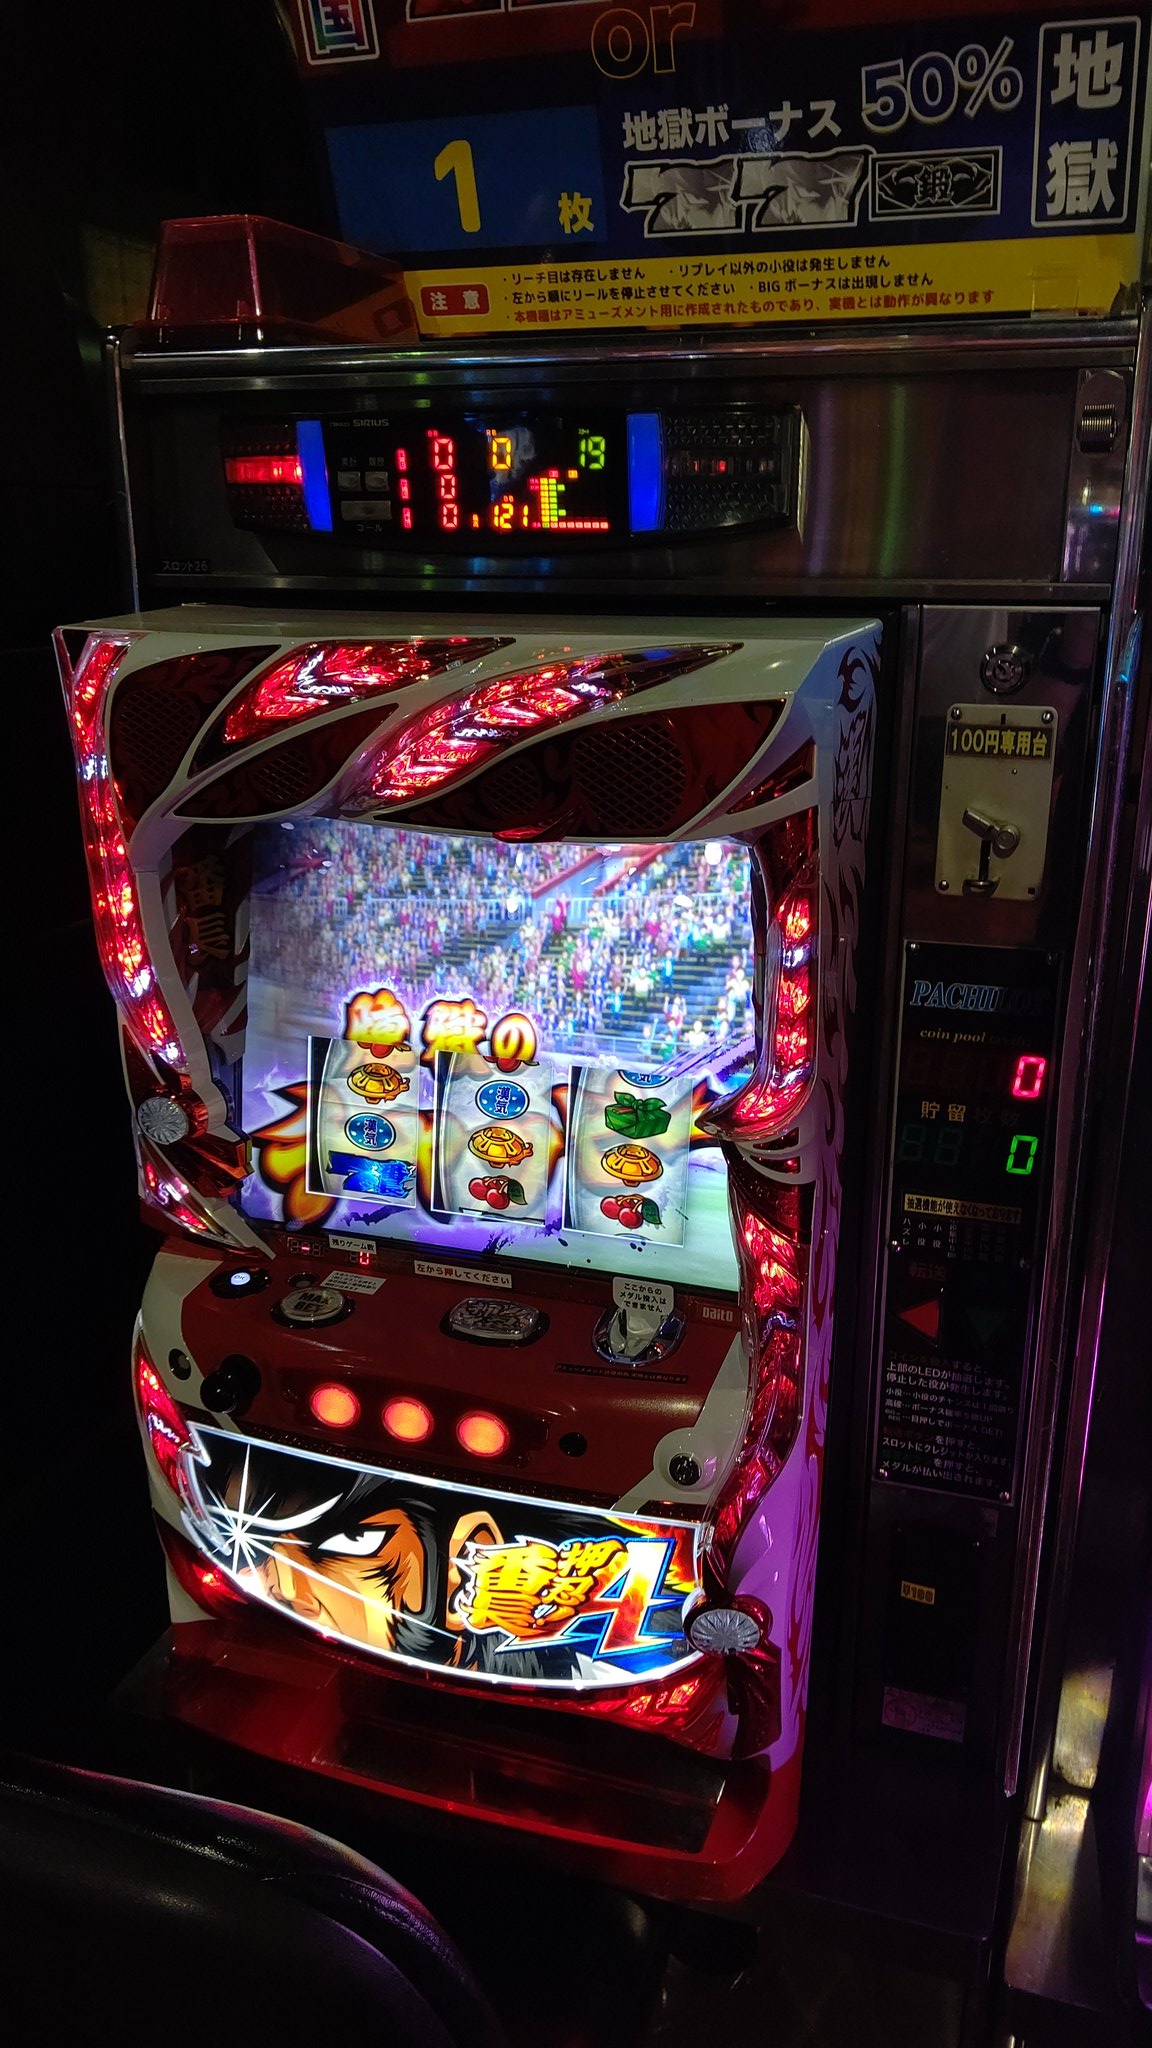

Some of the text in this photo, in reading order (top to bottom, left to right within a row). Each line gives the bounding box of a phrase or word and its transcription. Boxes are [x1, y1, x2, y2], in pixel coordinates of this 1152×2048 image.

[590, 2, 696, 80] or
[861, 35, 1023, 134] 50%
[621, 98, 842, 151] 地獄ボーナス
[1046, 30, 1125, 218] 地獄
[434, 139, 595, 234] 1 枚
[429, 288, 481, 313] 注意
[353, 418, 390, 428] SIRIUS
[492, 437, 512, 470] 0
[580, 436, 606, 470] 19
[162, 560, 209, 572] スロット26
[950, 727, 1048, 757] 100円専用台
[920, 1027, 950, 1041] coin
[953, 1031, 988, 1044] pool
[1012, 1055, 1047, 1099] 0
[1006, 1134, 1039, 1175] 0
[332, 1238, 374, 1251] 残りゲーム数
[417, 1263, 510, 1284] 左から押してください
[620, 1291, 667, 1305] メダル投入は
[624, 1283, 662, 1295] ここからの
[624, 1300, 663, 1313] できません
